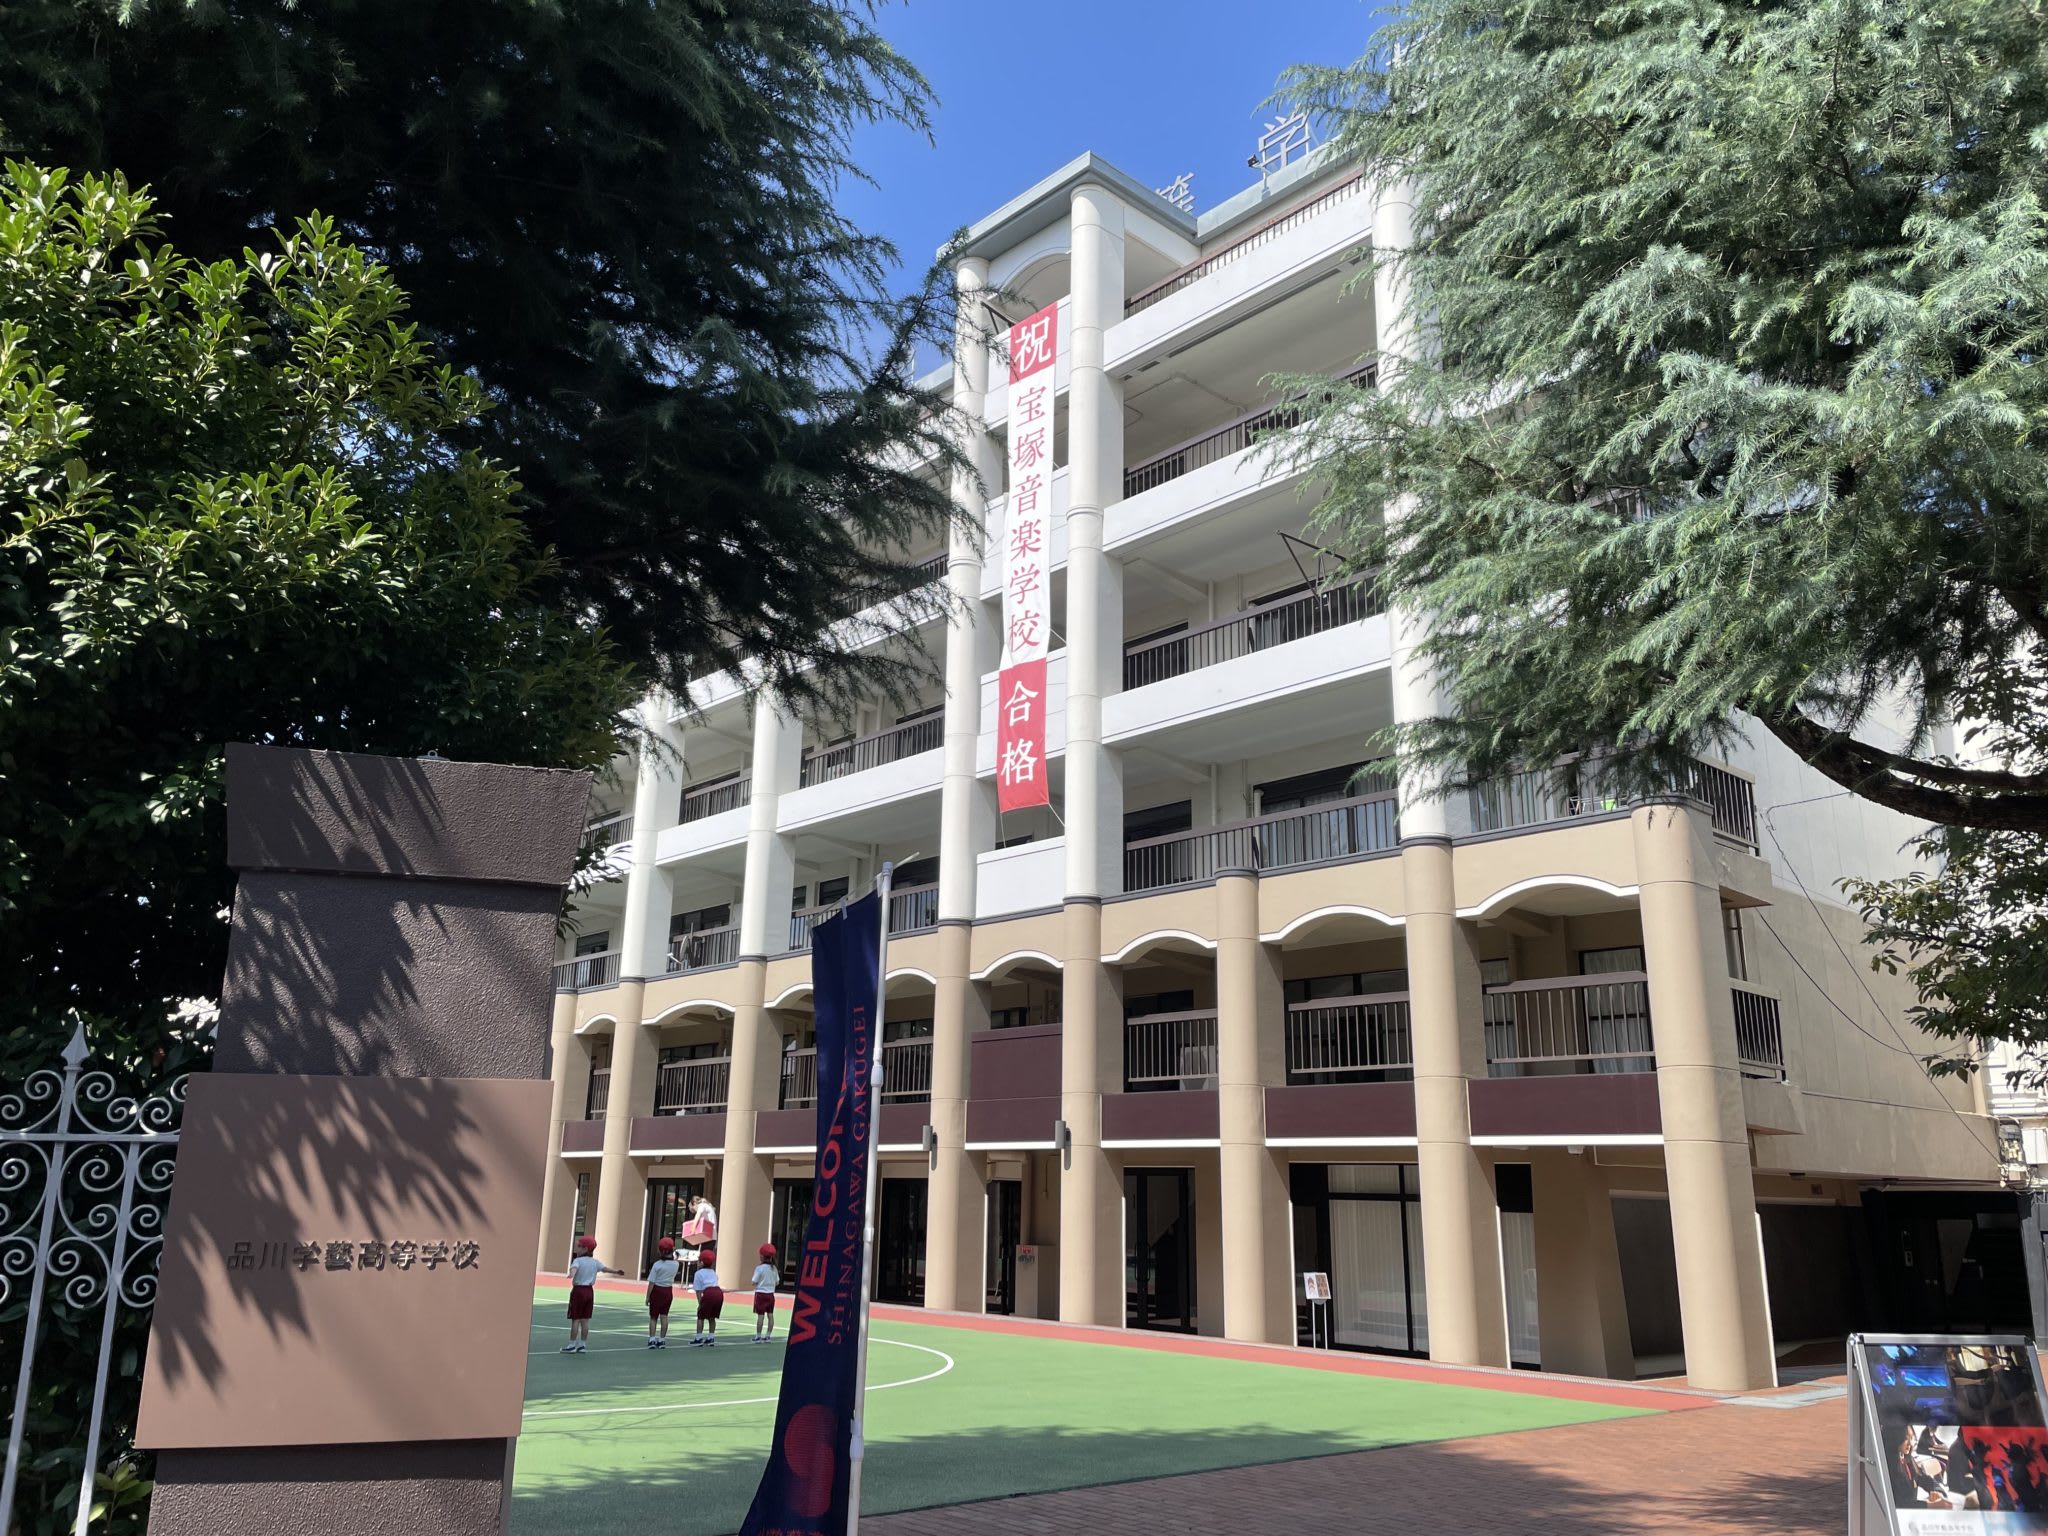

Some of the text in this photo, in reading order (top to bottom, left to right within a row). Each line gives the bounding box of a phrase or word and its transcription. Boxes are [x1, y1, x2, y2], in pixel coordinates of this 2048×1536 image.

[1000, 316, 1052, 787] 祝 宝塚音楽学校 合格
[227, 1240, 480, 1272] 品川学藝高等学校
[828, 1006, 867, 1345] SHINAGAWA GAKUGEI
